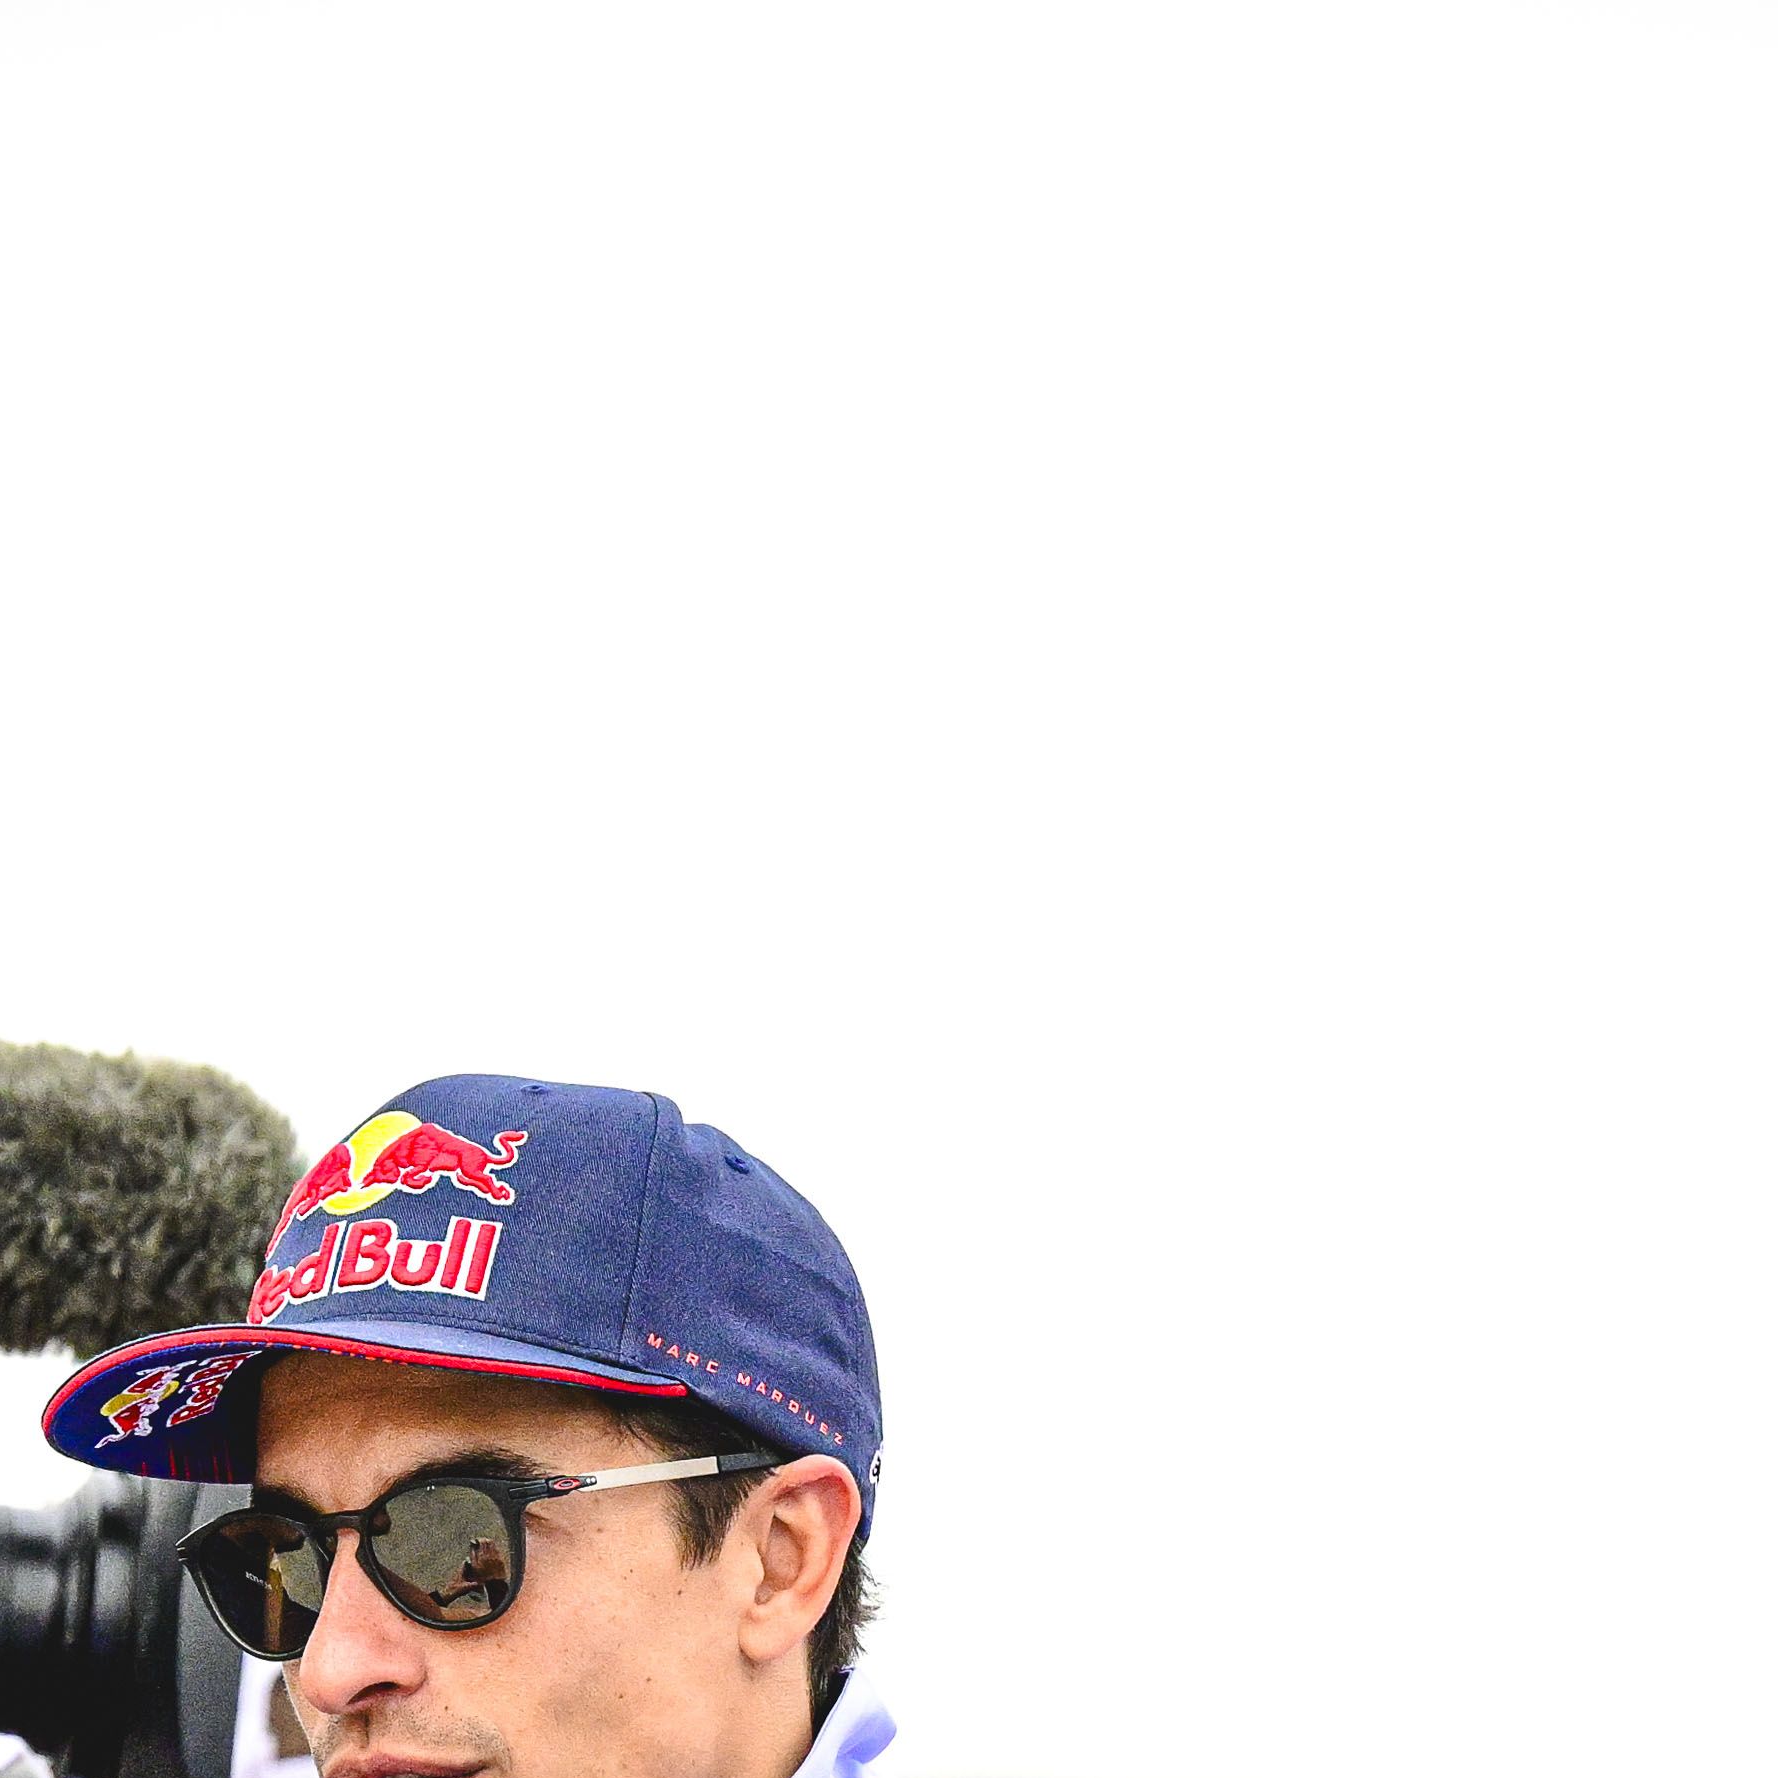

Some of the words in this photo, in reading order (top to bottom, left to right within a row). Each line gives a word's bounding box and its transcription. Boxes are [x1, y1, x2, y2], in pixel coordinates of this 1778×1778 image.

[336, 1217, 497, 1296] Bull
[647, 1332, 719, 1374] MARC
[737, 1372, 844, 1446] MARQUEZ
